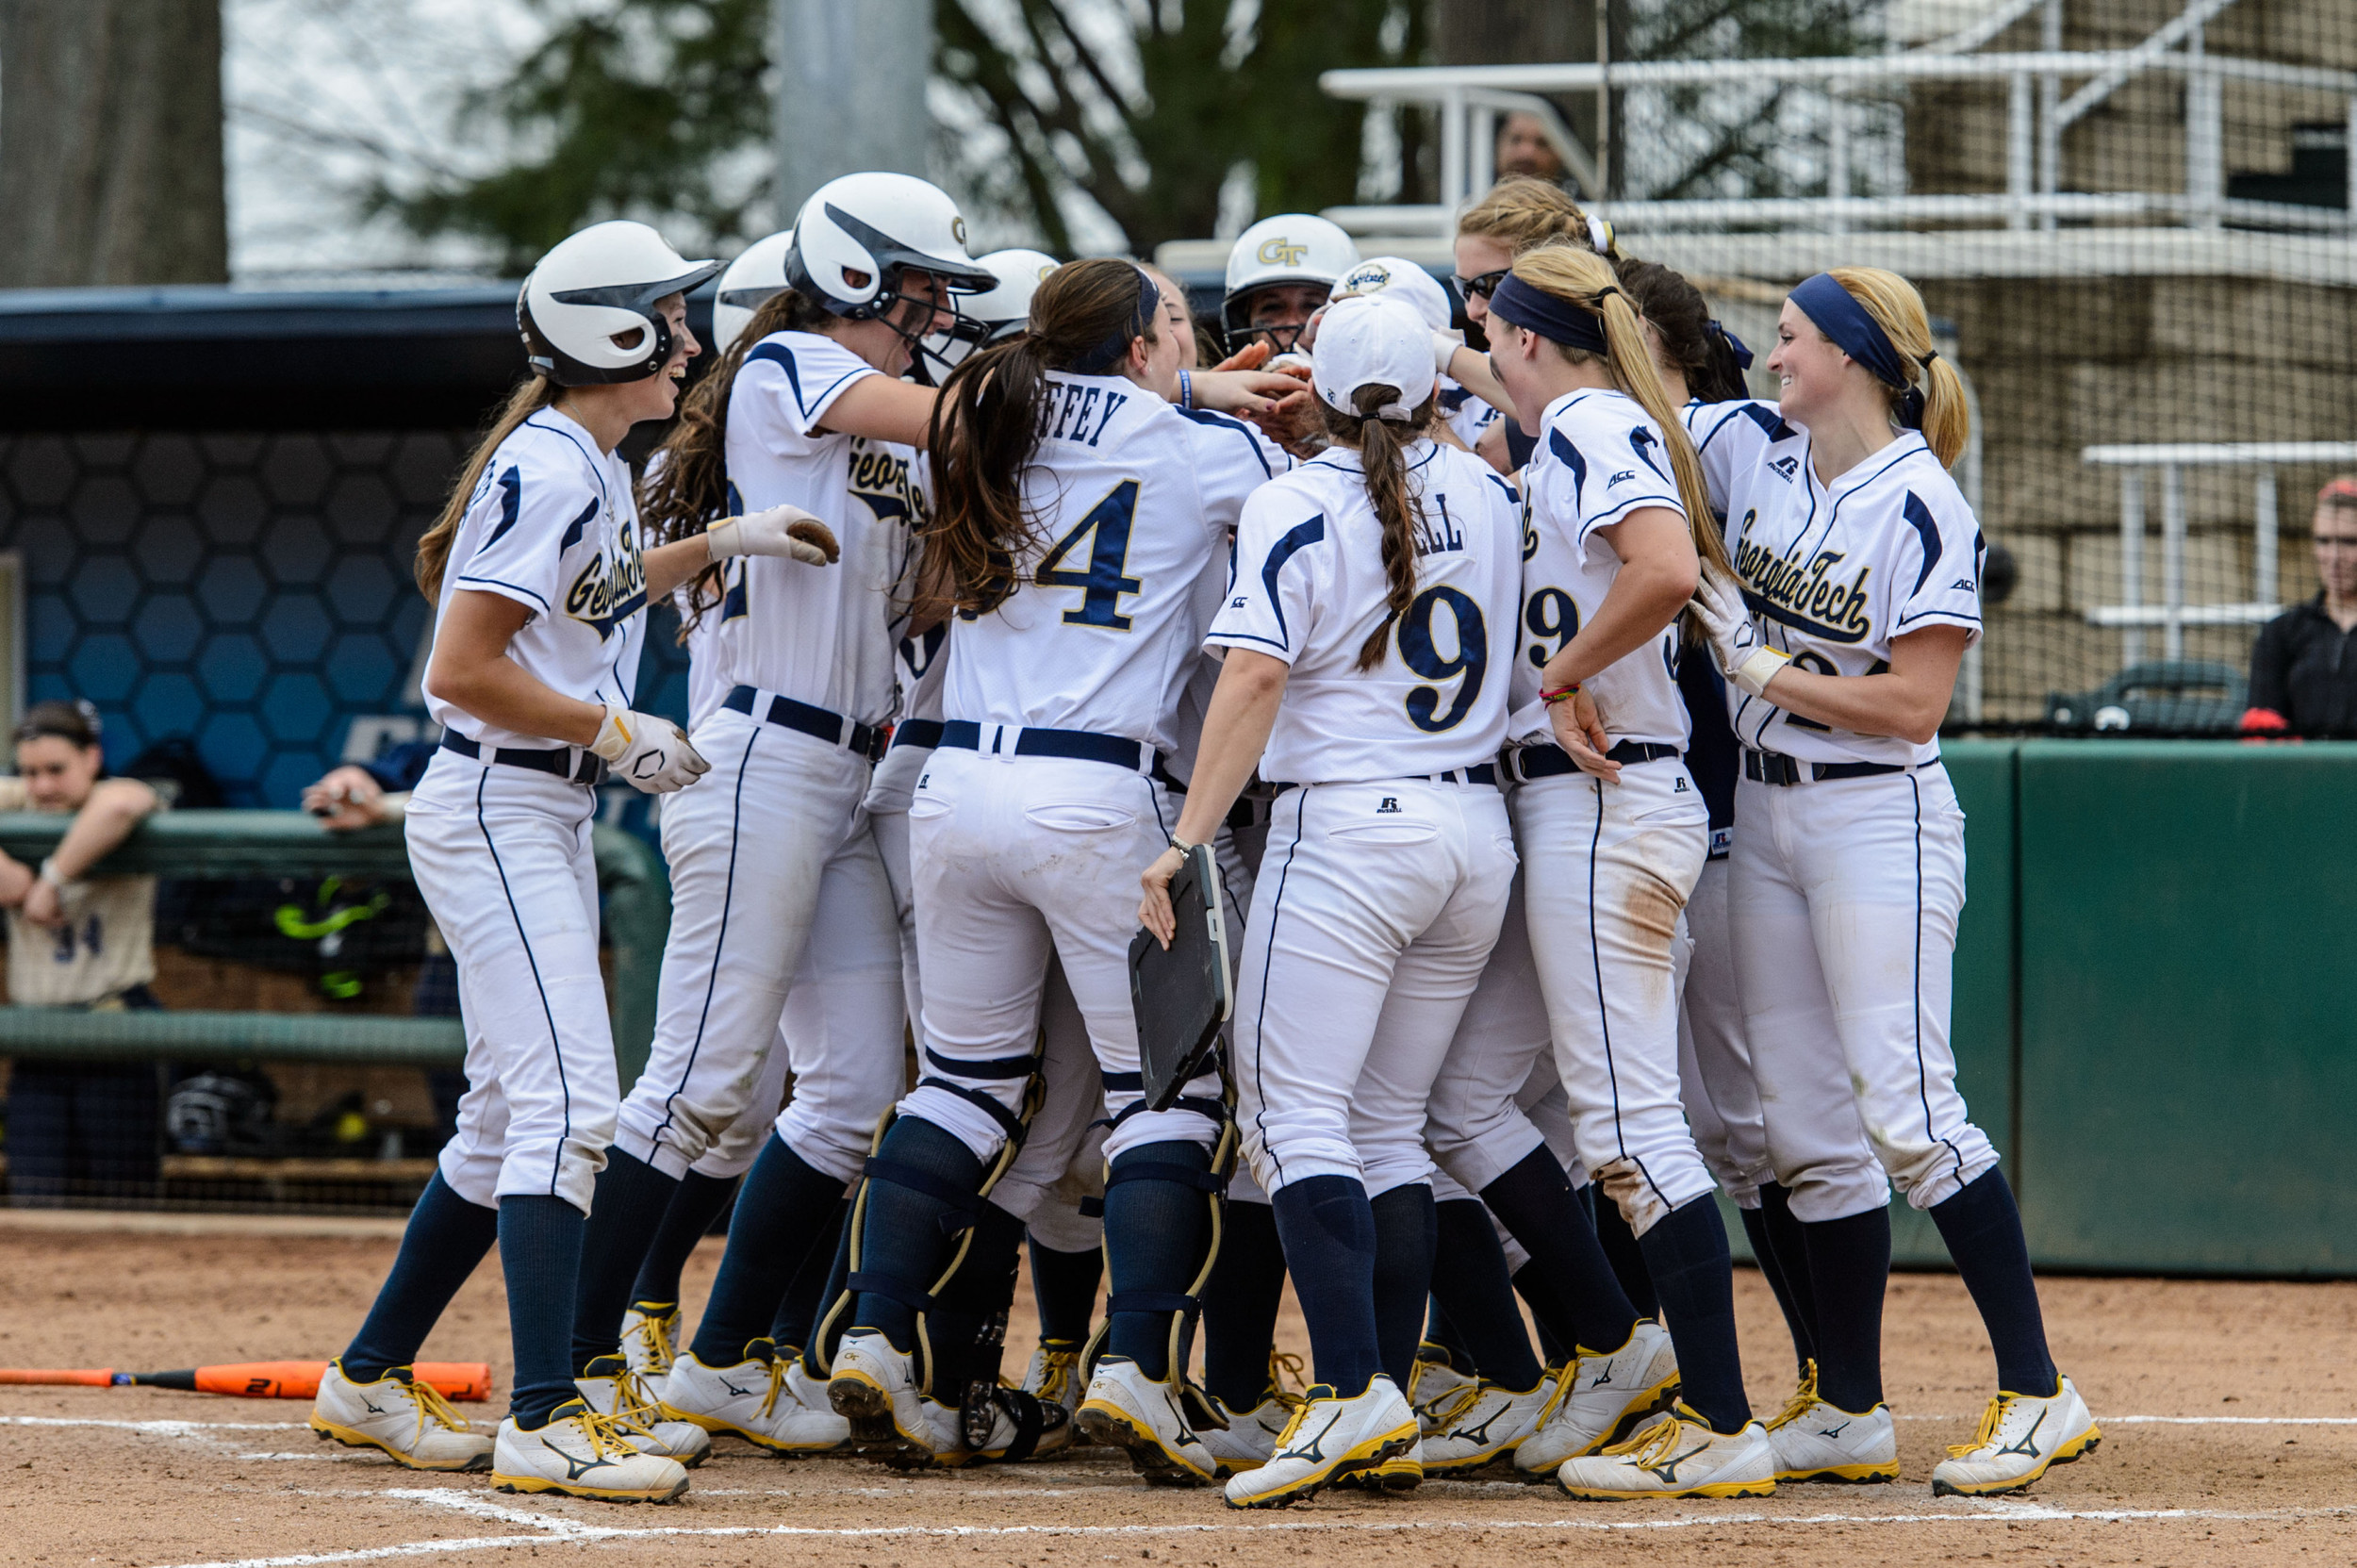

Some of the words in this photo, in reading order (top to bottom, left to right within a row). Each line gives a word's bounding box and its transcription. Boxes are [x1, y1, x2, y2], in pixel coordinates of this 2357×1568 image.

[1257, 237, 1308, 267] GT
[1037, 379, 1129, 447] FFEY
[1607, 470, 1636, 491] ACC
[1395, 582, 1489, 734] 9
[1525, 585, 1581, 669] 9
